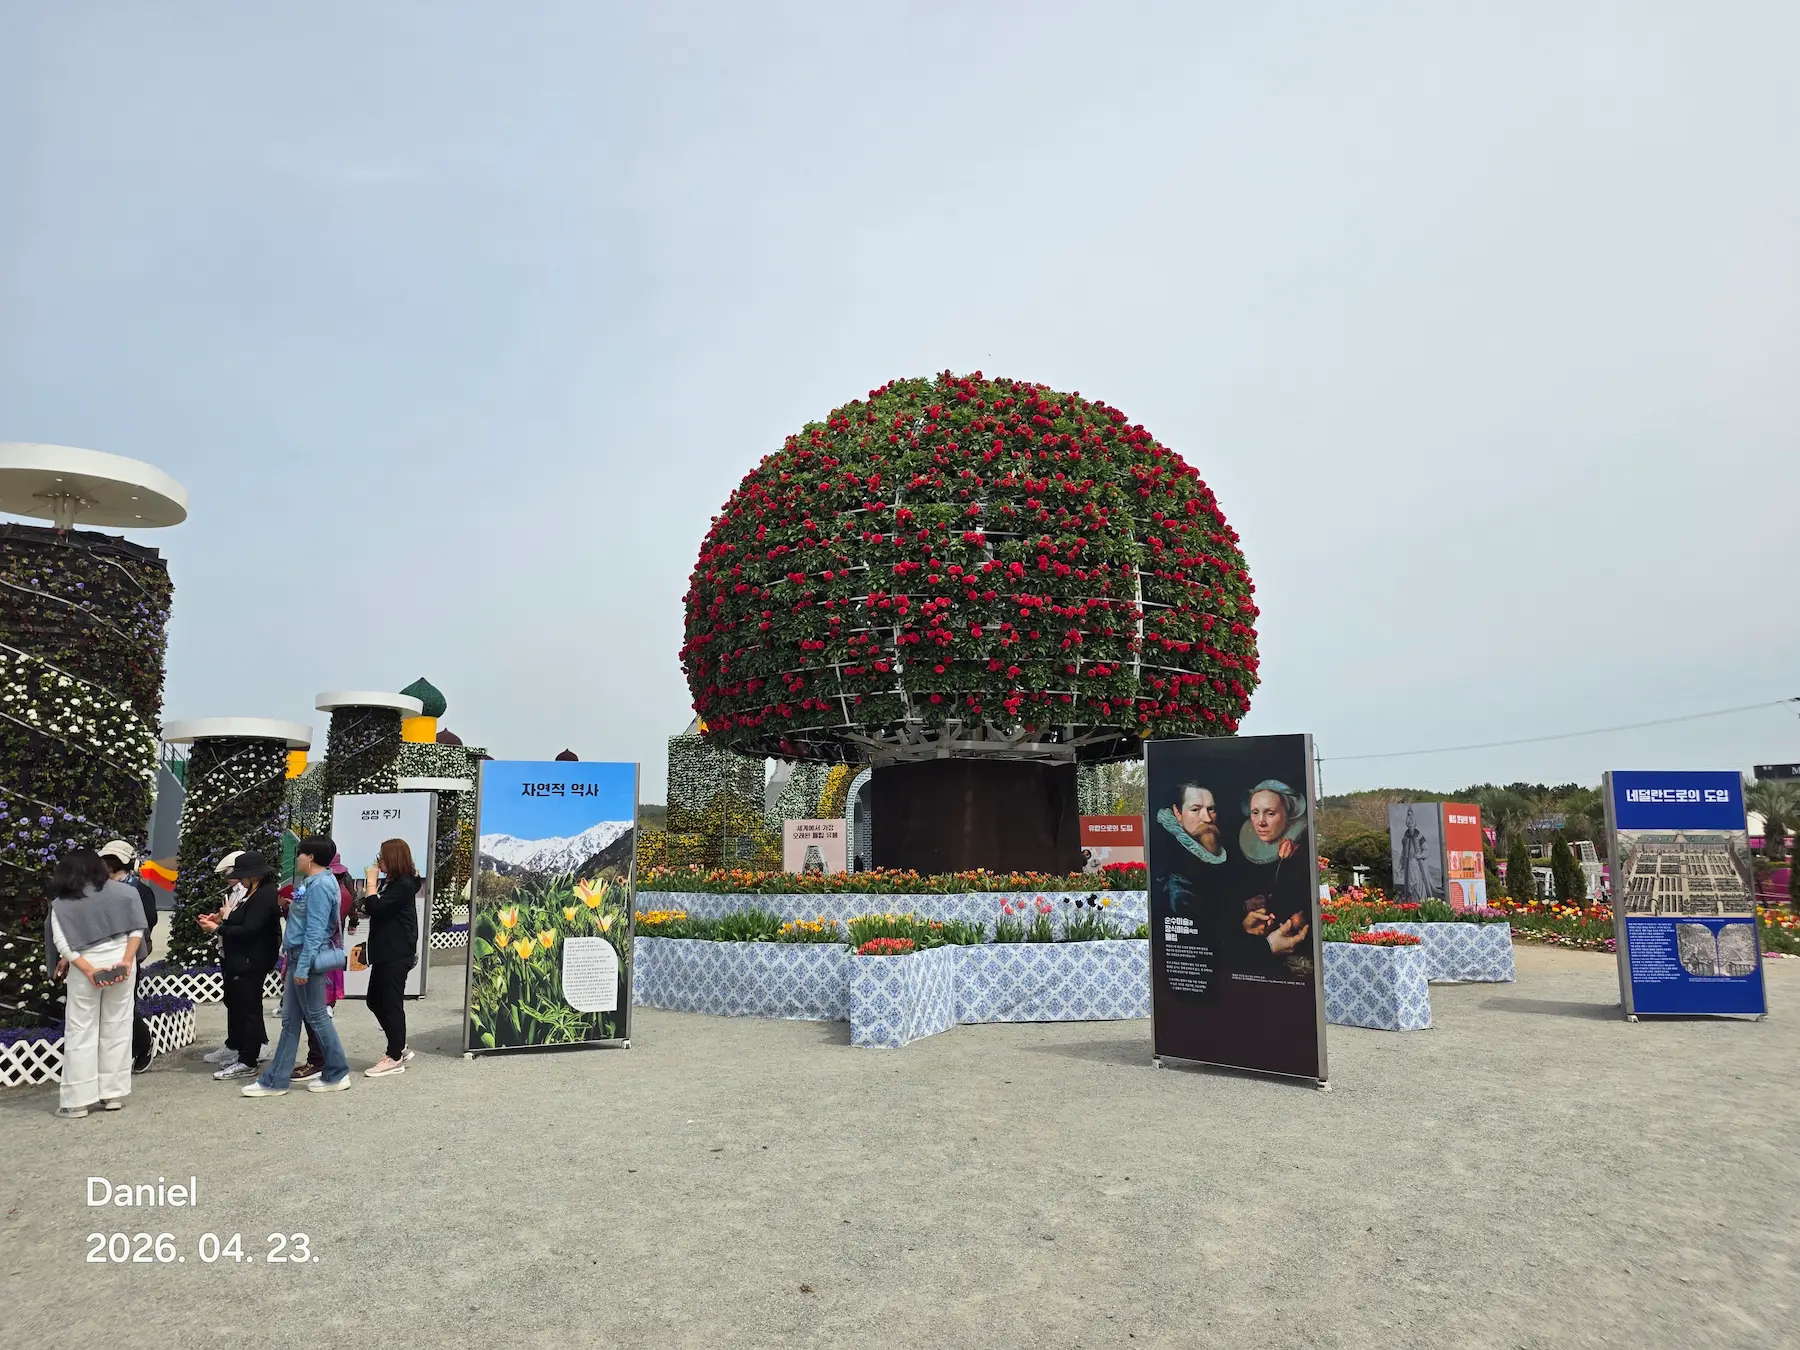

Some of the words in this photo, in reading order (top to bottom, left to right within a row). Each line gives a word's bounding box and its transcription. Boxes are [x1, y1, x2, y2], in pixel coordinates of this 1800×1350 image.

[521, 783, 565, 797] 자연적
[571, 783, 599, 797] 역사
[1626, 789, 1700, 803] 네덜란드로의
[1704, 789, 1729, 803] 도입
[361, 809, 379, 820] 생장
[383, 809, 401, 820] 주기
[796, 824, 820, 832] 세계에서
[1088, 824, 1119, 832] 유럽으로의
[1120, 824, 1133, 832] 도입
[1164, 916, 1194, 926] 순수미술과
